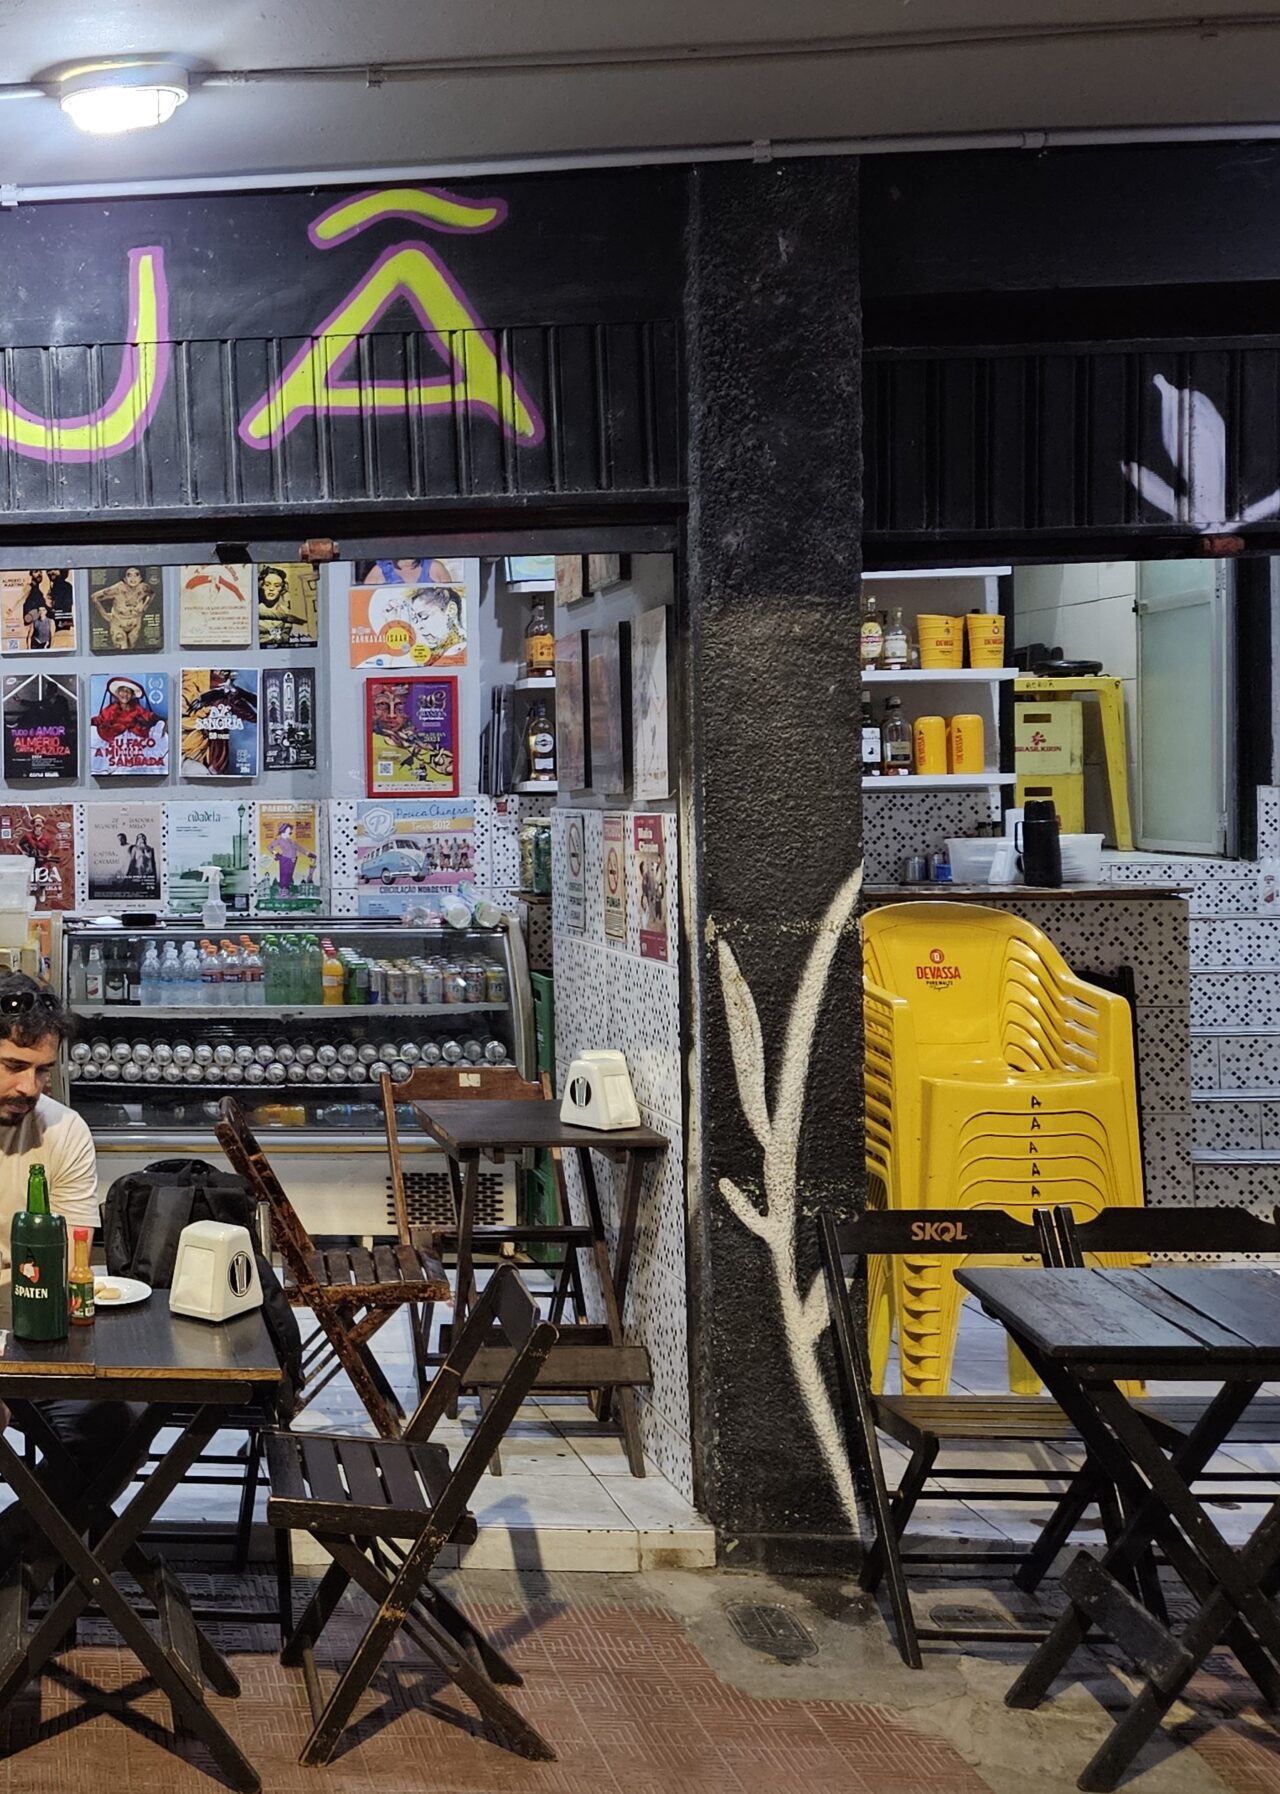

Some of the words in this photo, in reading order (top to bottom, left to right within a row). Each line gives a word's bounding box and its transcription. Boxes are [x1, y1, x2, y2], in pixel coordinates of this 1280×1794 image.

[36, 726, 65, 736] AMOR
[187, 810, 220, 822] cidadela
[916, 966, 962, 980] DEVASSA
[1031, 1095, 1042, 1109] A
[1031, 1117, 1040, 1131] A
[1029, 1141, 1038, 1154] A
[1032, 1162, 1040, 1177] A
[1031, 1185, 1040, 1198] A
[911, 1222, 968, 1242] SKOL
[15, 1284, 48, 1299] SPATEN
